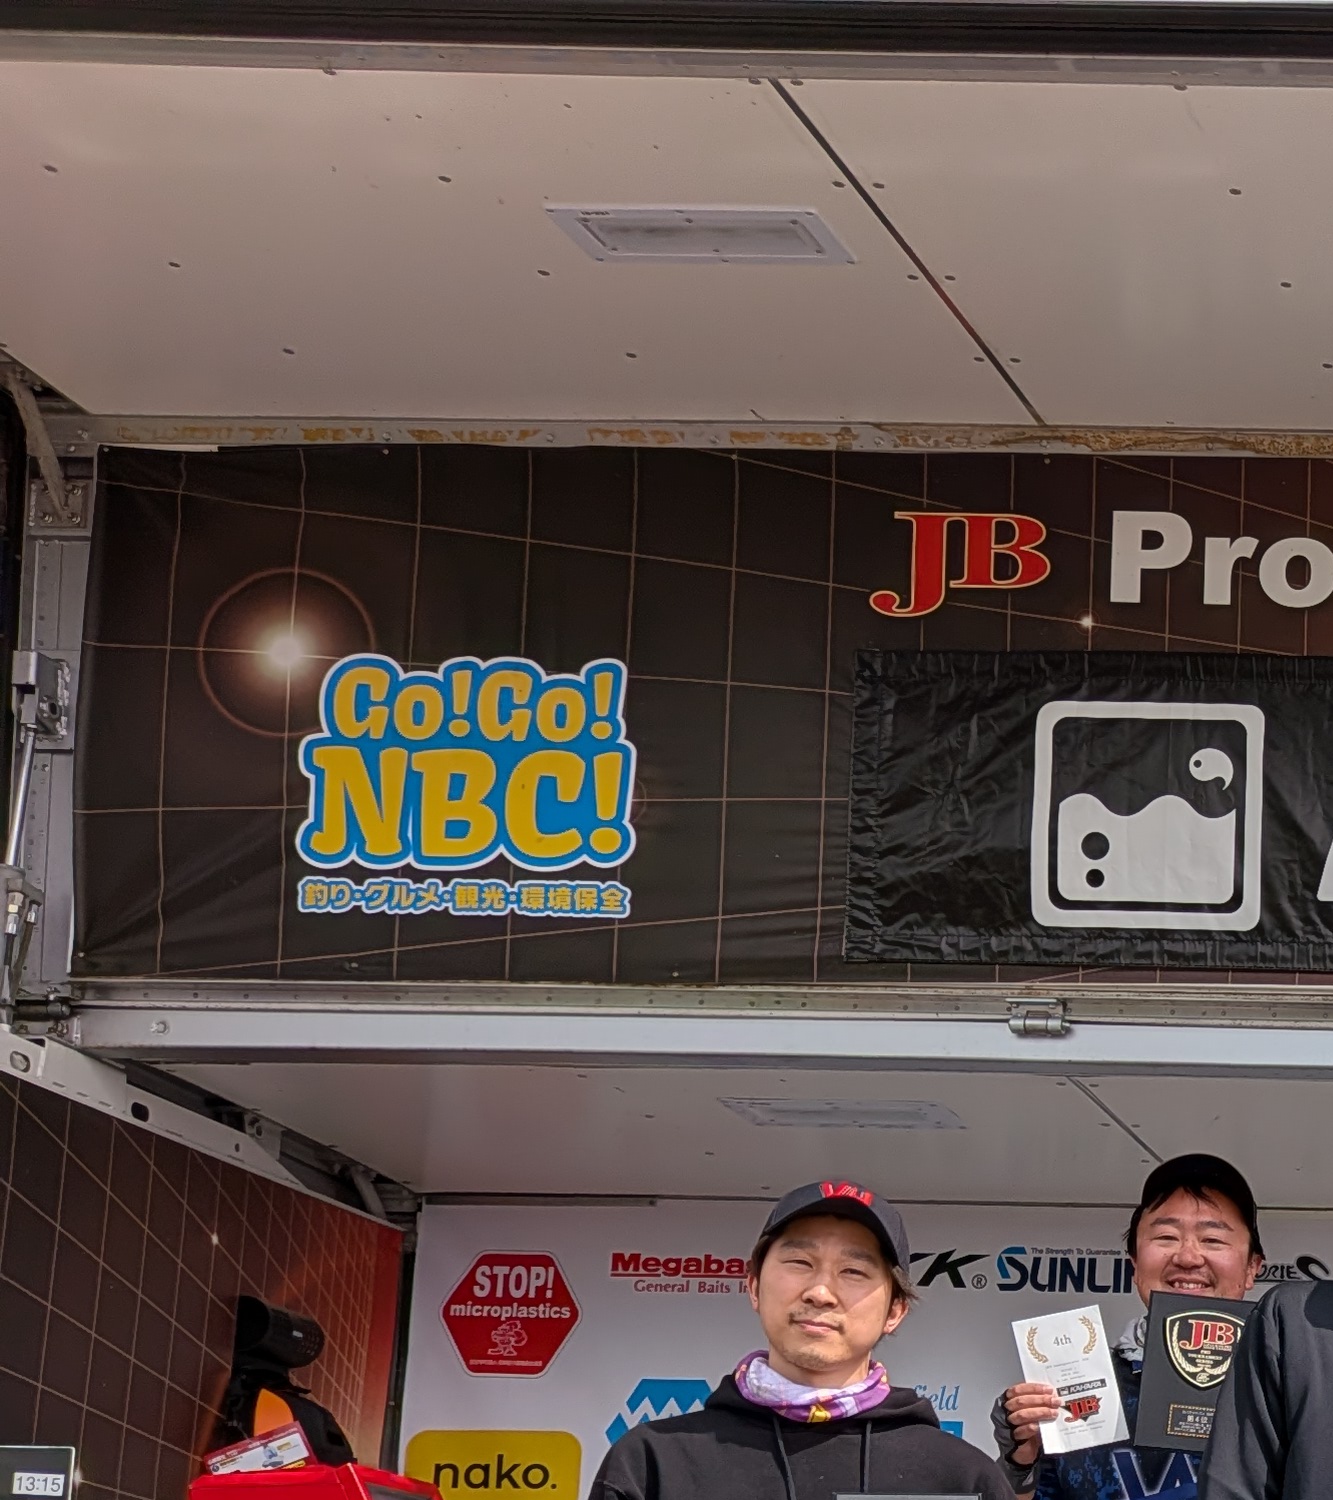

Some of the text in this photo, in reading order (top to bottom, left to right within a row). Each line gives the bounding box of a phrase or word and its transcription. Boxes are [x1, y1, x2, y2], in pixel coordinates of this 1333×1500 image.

[870, 511, 1051, 618] JB
[311, 747, 626, 859] NBC!
[474, 1266, 555, 1298] STOP!
[634, 1280, 731, 1293] General Baits
[451, 1302, 571, 1320] microplastics
[1053, 1334, 1072, 1347] 4th
[1180, 1319, 1235, 1350] JB
[914, 1385, 960, 1411] eld
[15, 1475, 61, 1493] 13:15
[433, 1454, 557, 1490] nako.
